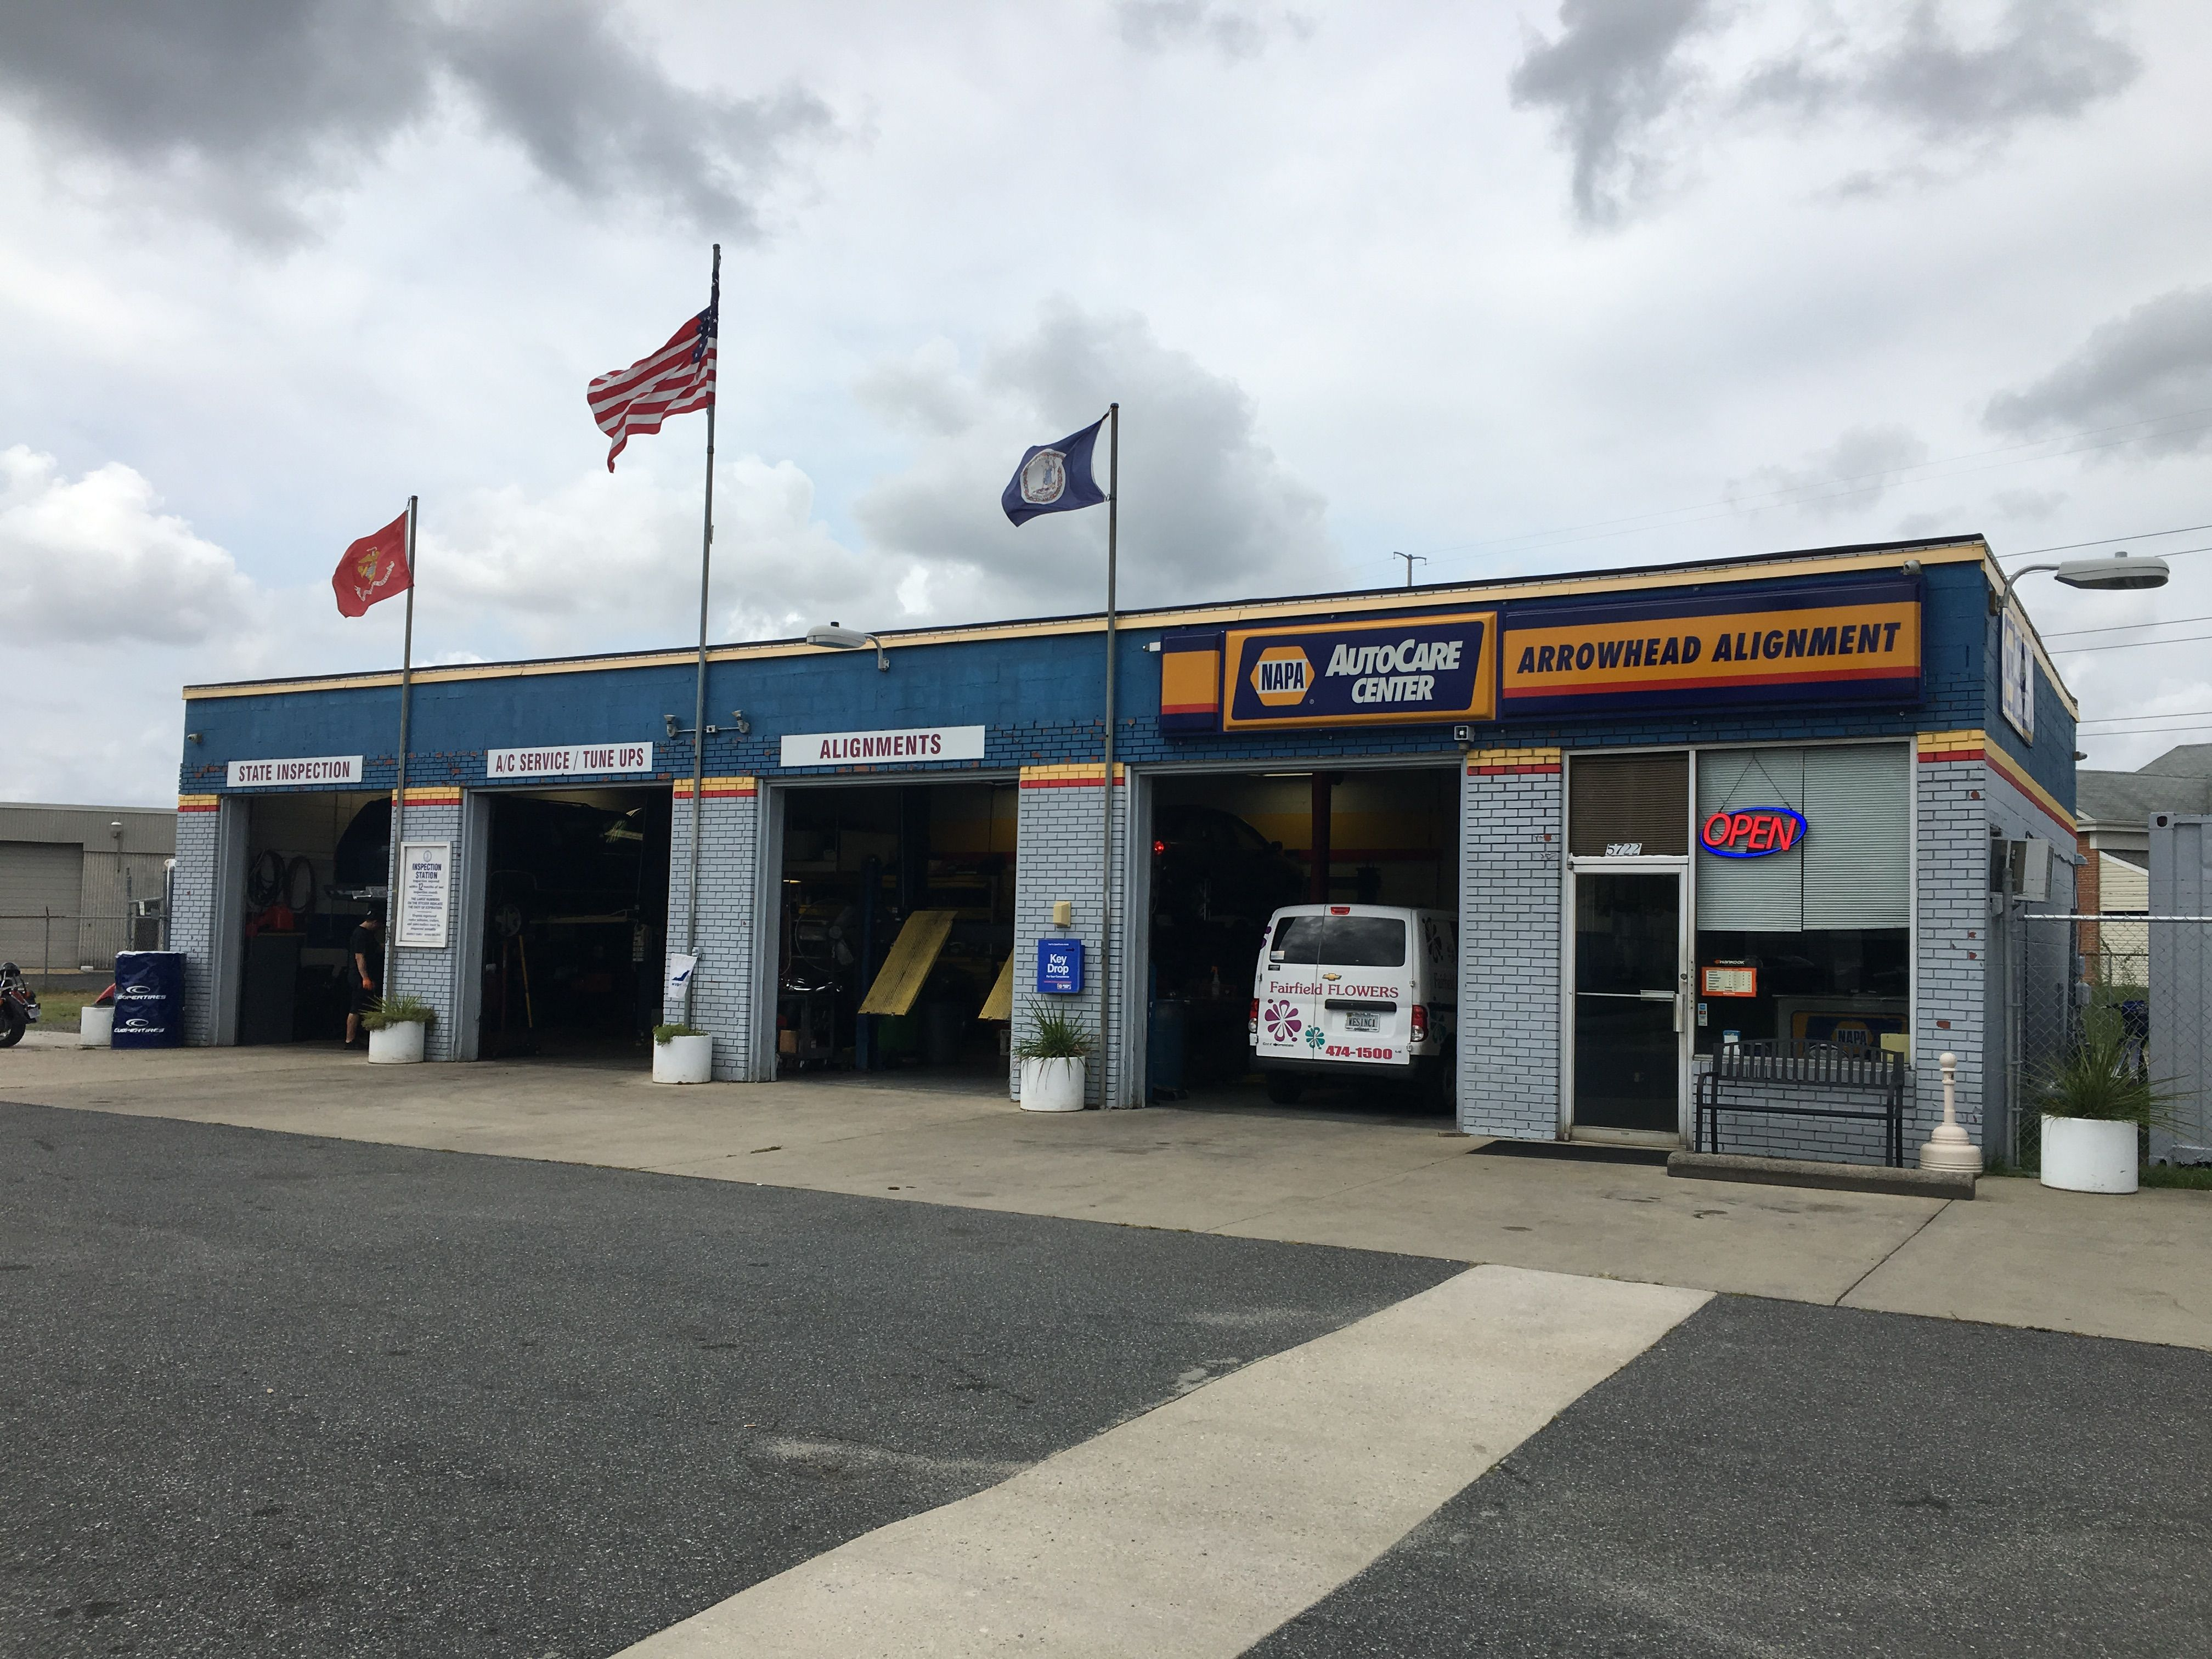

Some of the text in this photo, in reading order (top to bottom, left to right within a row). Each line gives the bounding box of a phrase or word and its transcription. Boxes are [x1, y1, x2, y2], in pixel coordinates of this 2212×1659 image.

[1517, 623, 1901, 674] ARROWHEAD ALIGNMENT
[1262, 662, 1304, 691] NAPA
[1351, 675, 1435, 703] CENTER
[820, 733, 942, 759] ALIGNMENTS
[495, 754, 515, 774] A/C
[520, 752, 570, 771] SERVICE
[583, 749, 614, 769] TUNE
[619, 748, 644, 767] UPS
[239, 761, 351, 782] STATE INSPECTION
[1703, 812, 1797, 851] OPEN
[1606, 843, 1640, 855] 5722
[412, 863, 442, 871] INSPECTION
[1047, 963, 1069, 975] Drop
[1050, 953, 1067, 966] Key
[1269, 981, 1399, 998] Fairfield FLOWERS
[1838, 1030, 1866, 1045] NAPA
[1325, 1045, 1392, 1059] 474-1500
